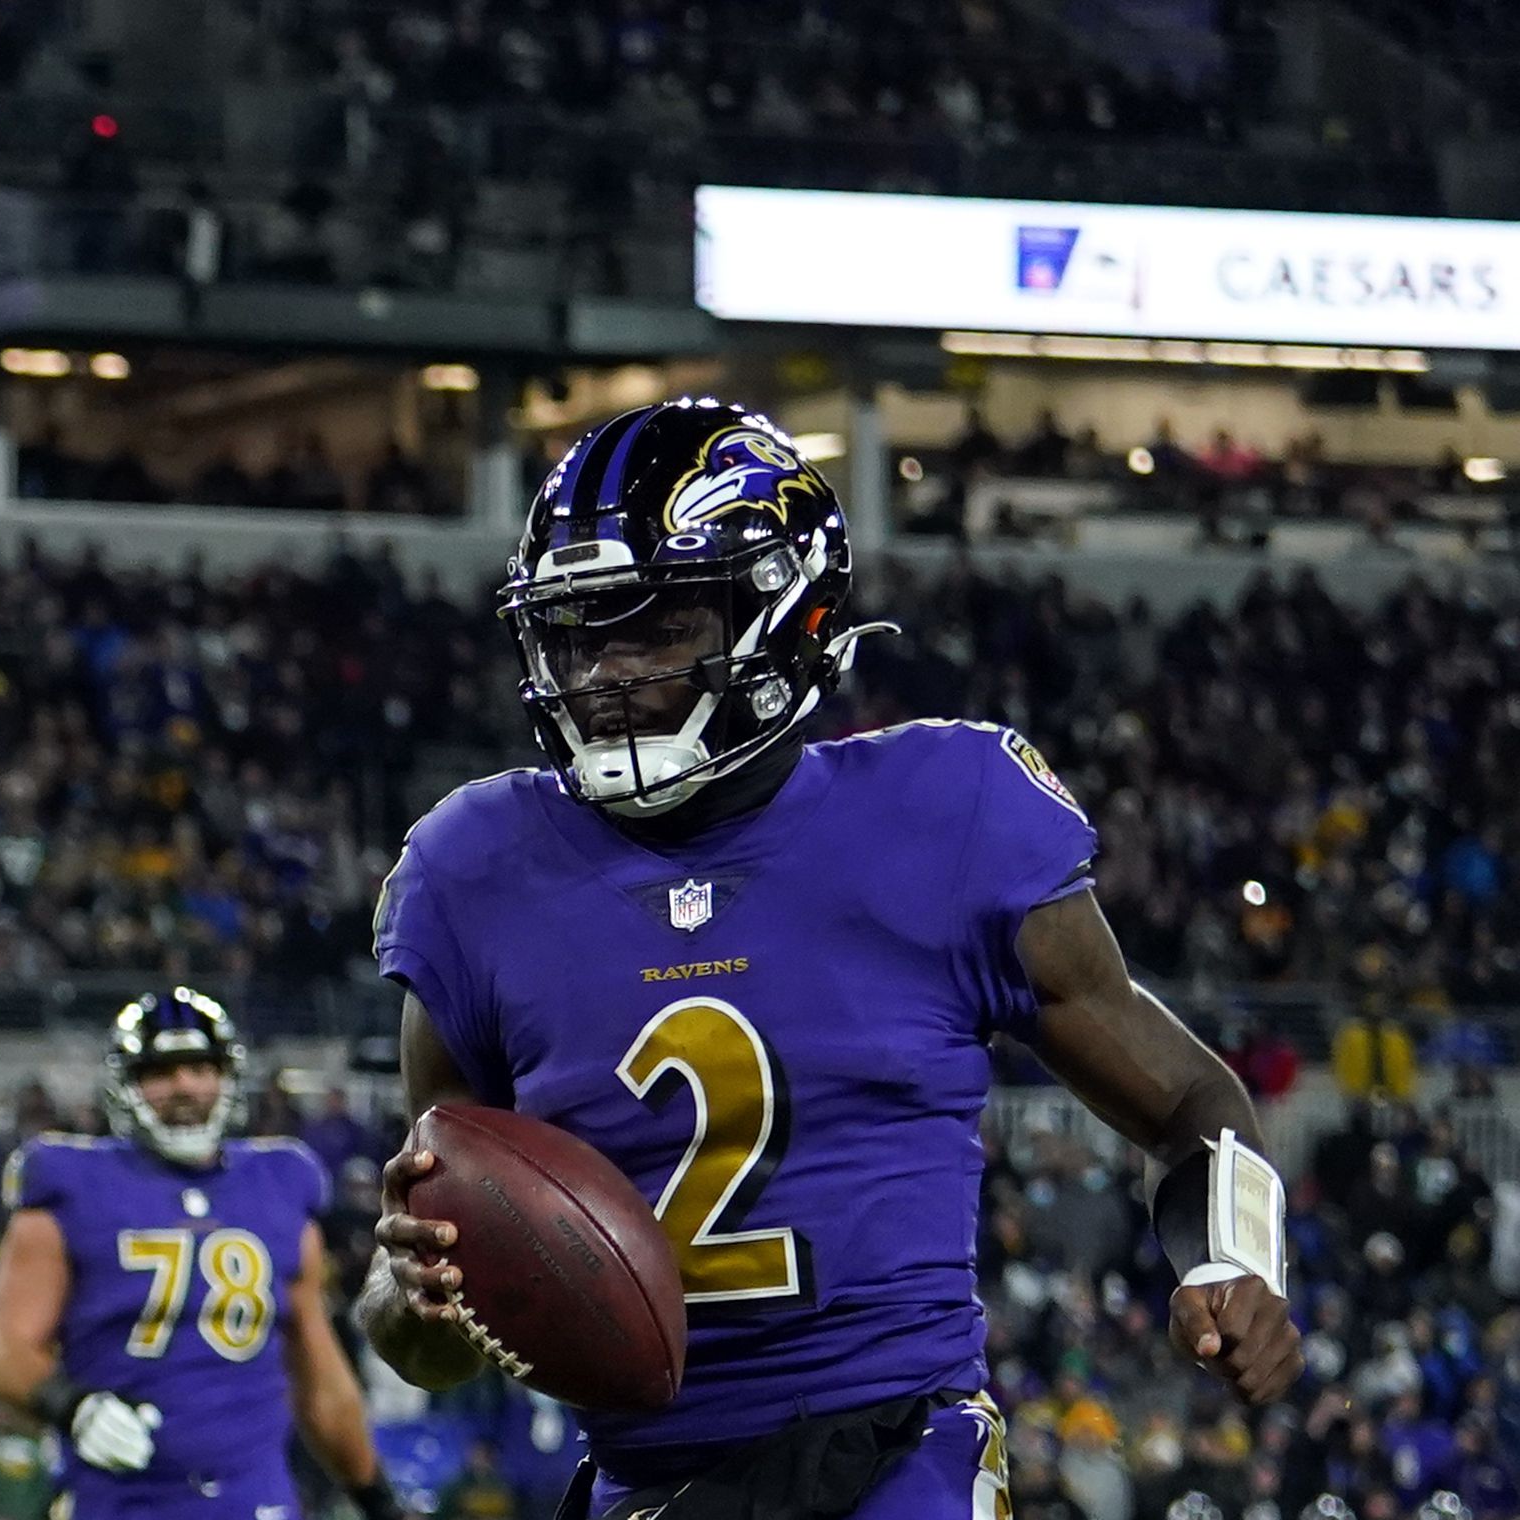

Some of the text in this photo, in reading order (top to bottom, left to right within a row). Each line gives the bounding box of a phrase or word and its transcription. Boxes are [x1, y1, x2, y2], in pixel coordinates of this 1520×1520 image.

[1213, 243, 1501, 310] CAESARS
[640, 957, 750, 983] RAVENS
[614, 996, 803, 1305] 2
[117, 1228, 276, 1362] 78
